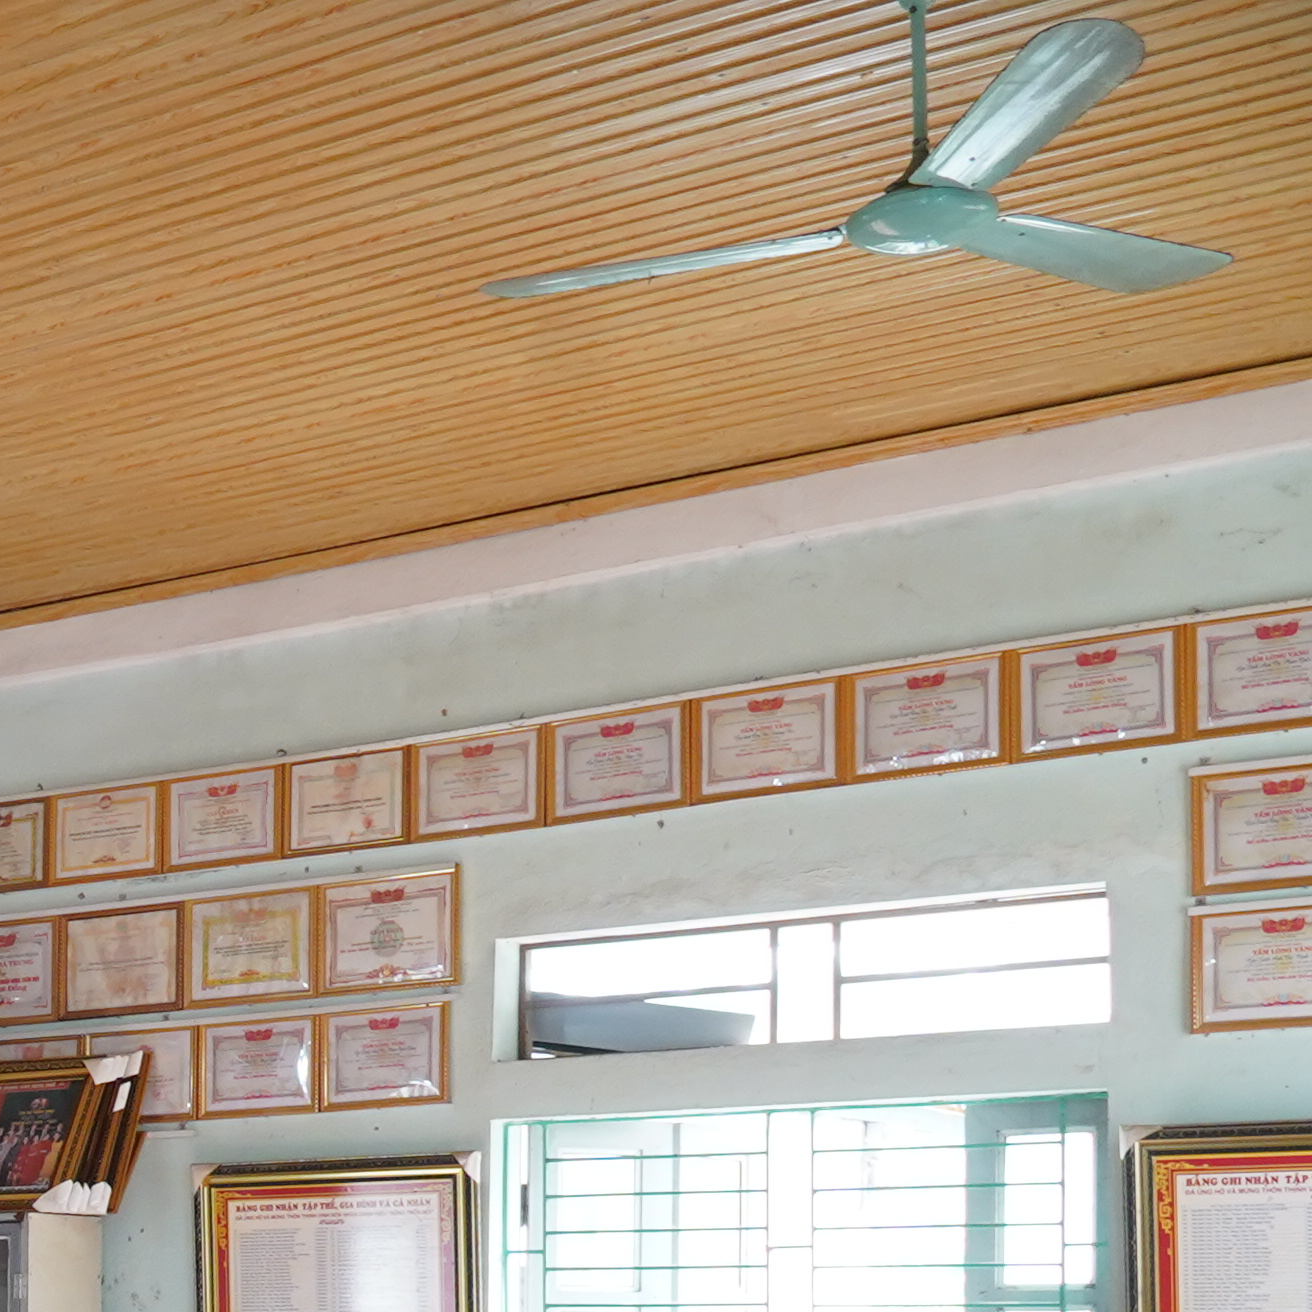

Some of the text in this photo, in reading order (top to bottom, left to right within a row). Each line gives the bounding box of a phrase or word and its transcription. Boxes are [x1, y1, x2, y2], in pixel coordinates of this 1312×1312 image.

[1186, 1173, 1309, 1187] BẢNG GHI NHẬN TẬP
[236, 1202, 257, 1212] BẢNG
[276, 1201, 298, 1211] NHẬN
[302, 1201, 318, 1211] TẬP
[319, 1197, 338, 1209] THỂ,
[339, 1200, 354, 1208] GIA
[356, 1199, 376, 1208] ĐÌNH
[379, 1198, 390, 1207] VÀ
[393, 1197, 403, 1206] CÁ
[407, 1197, 431, 1207] NHÂN
